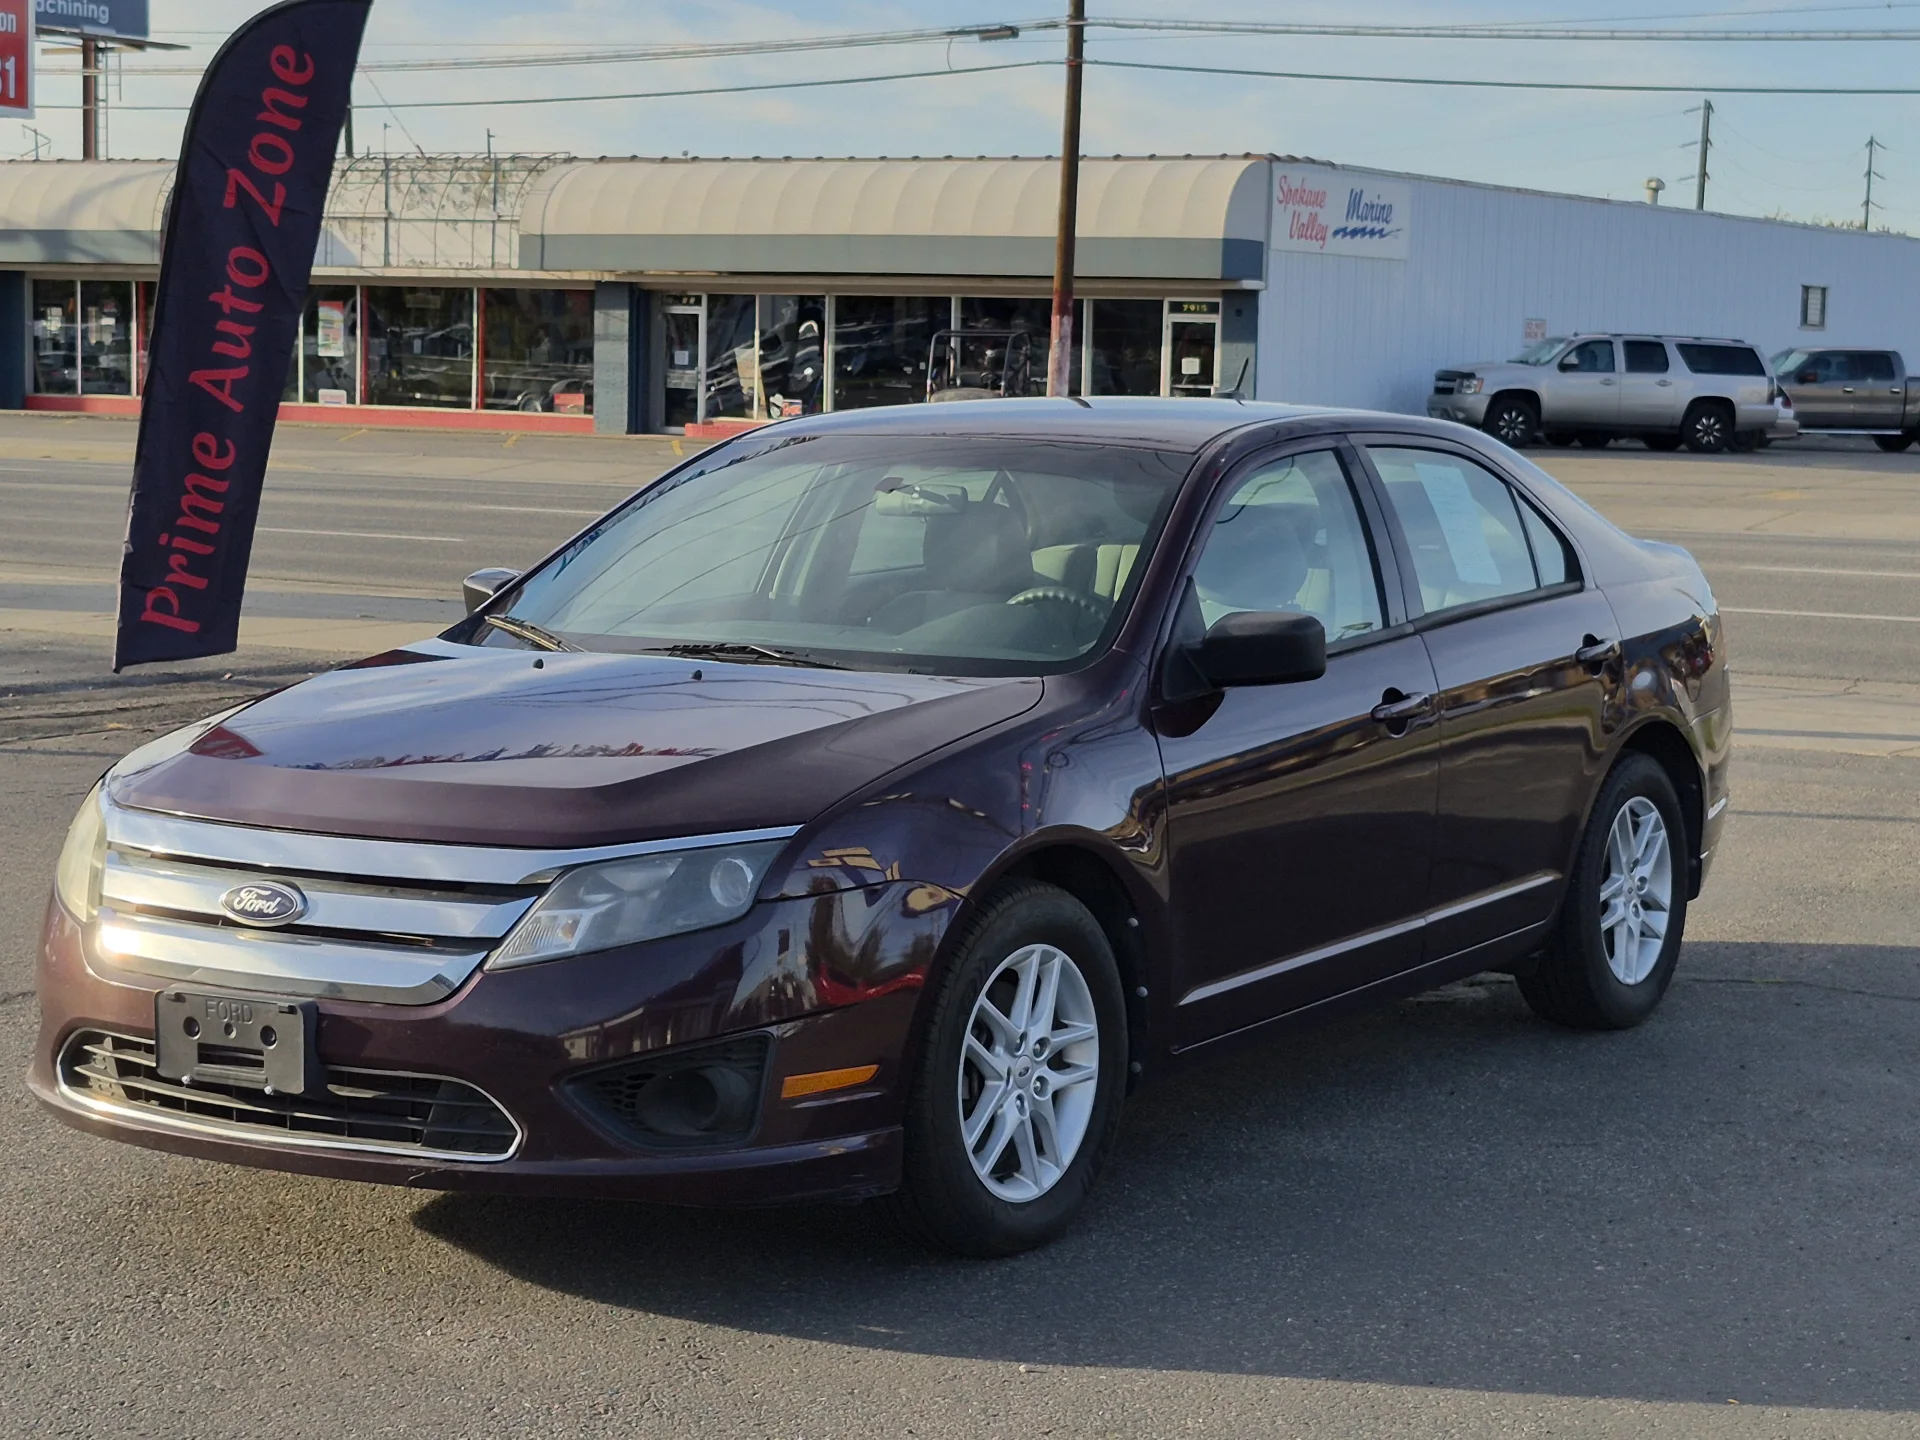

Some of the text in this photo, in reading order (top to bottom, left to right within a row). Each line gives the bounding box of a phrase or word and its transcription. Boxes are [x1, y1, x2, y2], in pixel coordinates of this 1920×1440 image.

[0, 55, 16, 99] 1
[1277, 175, 1326, 213] Spokane
[1345, 187, 1393, 225] Marine
[1289, 210, 1329, 250] Valley
[142, 44, 315, 632] Prime Auto Zone
[232, 887, 282, 914] Ford
[205, 1000, 254, 1024] FORD
